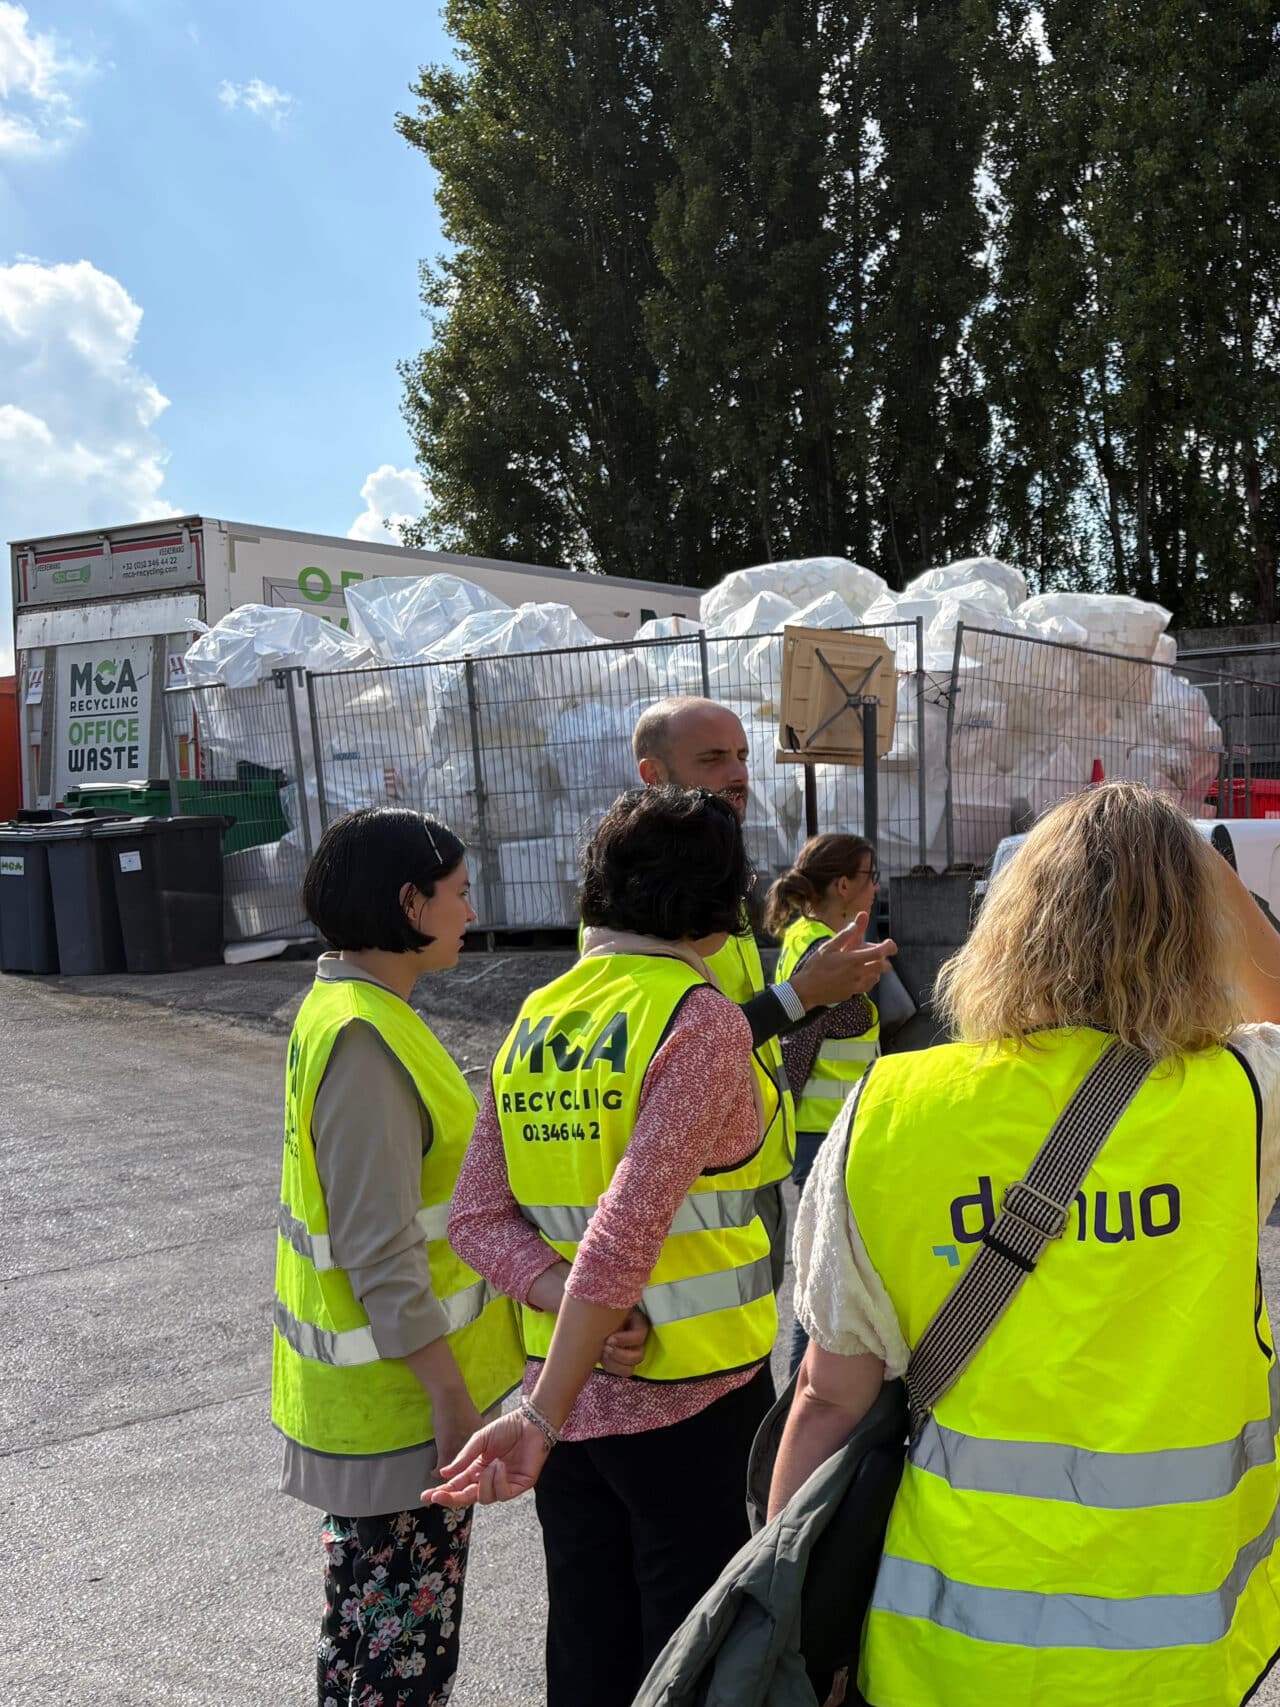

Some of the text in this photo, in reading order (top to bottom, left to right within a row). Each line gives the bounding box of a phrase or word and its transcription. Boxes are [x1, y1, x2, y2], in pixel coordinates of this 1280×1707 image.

[70, 658, 138, 697] MCA
[70, 696, 138, 712] RECYCLING
[68, 718, 139, 746] OFFICE
[68, 746, 139, 772] WASTE
[503, 1011, 628, 1074] MCA
[589, 1121, 601, 1141] 2
